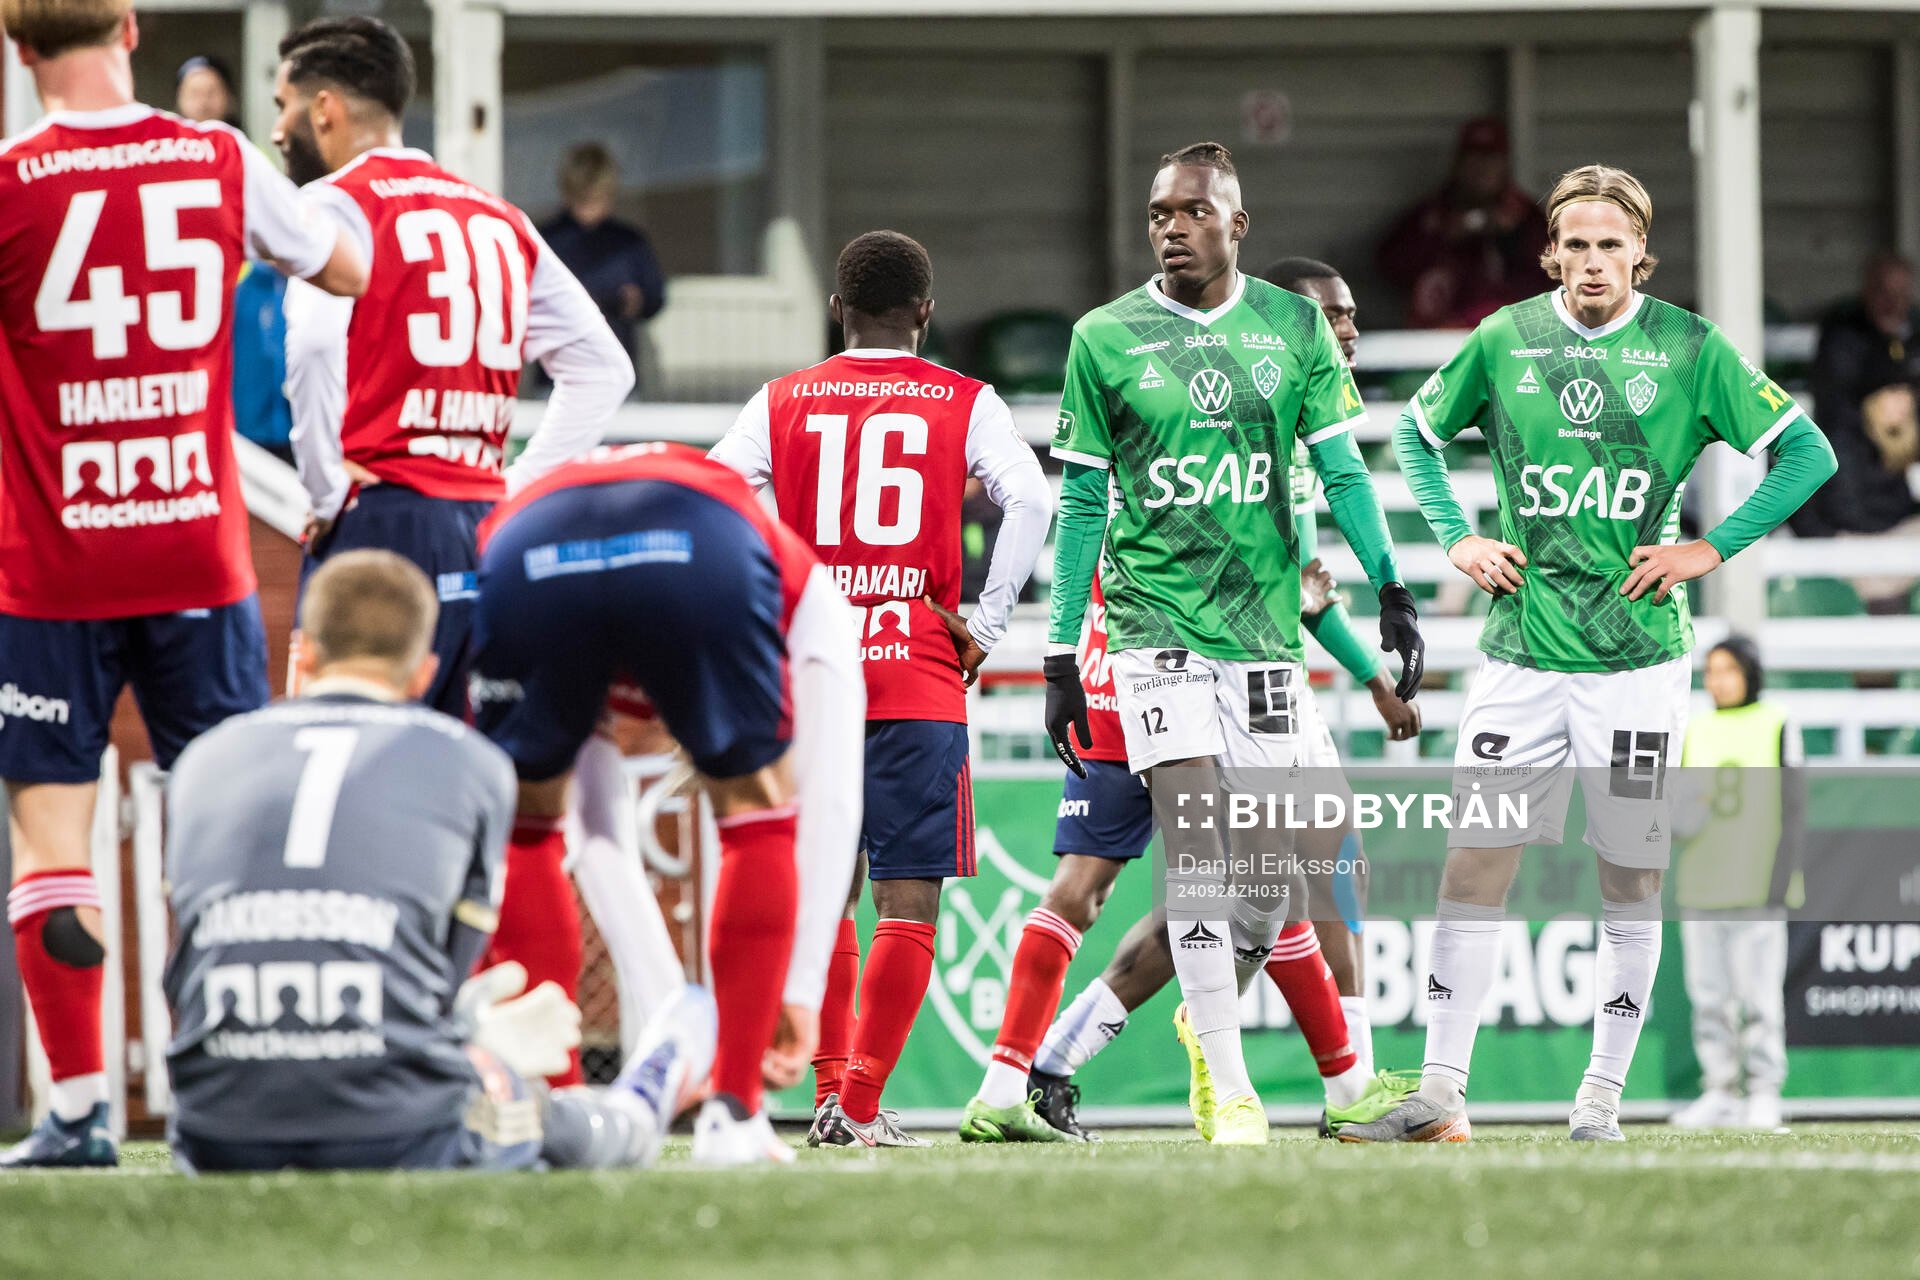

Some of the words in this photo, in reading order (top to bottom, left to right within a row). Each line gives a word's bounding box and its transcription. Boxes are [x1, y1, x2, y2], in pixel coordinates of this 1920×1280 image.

[34, 178, 225, 360] 45
[395, 208, 529, 371] 30
[1621, 348, 1670, 362] S.K.M.A.
[792, 380, 954, 401] (LUNDBERG&CO)
[1139, 379, 1164, 390] SELECT
[1516, 385, 1540, 394] SELECT
[1190, 418, 1232, 430] Borlänge
[1558, 428, 1601, 441] Borlänge
[805, 412, 928, 546] 16
[1144, 452, 1271, 508] SSAB
[1519, 464, 1651, 520] SSAB
[1133, 674, 1183, 694] Borlänge
[1141, 706, 1168, 736] 12
[283, 726, 360, 869] 1
[1180, 941, 1223, 950] SELECT
[1603, 1008, 1640, 1018] SELECT
